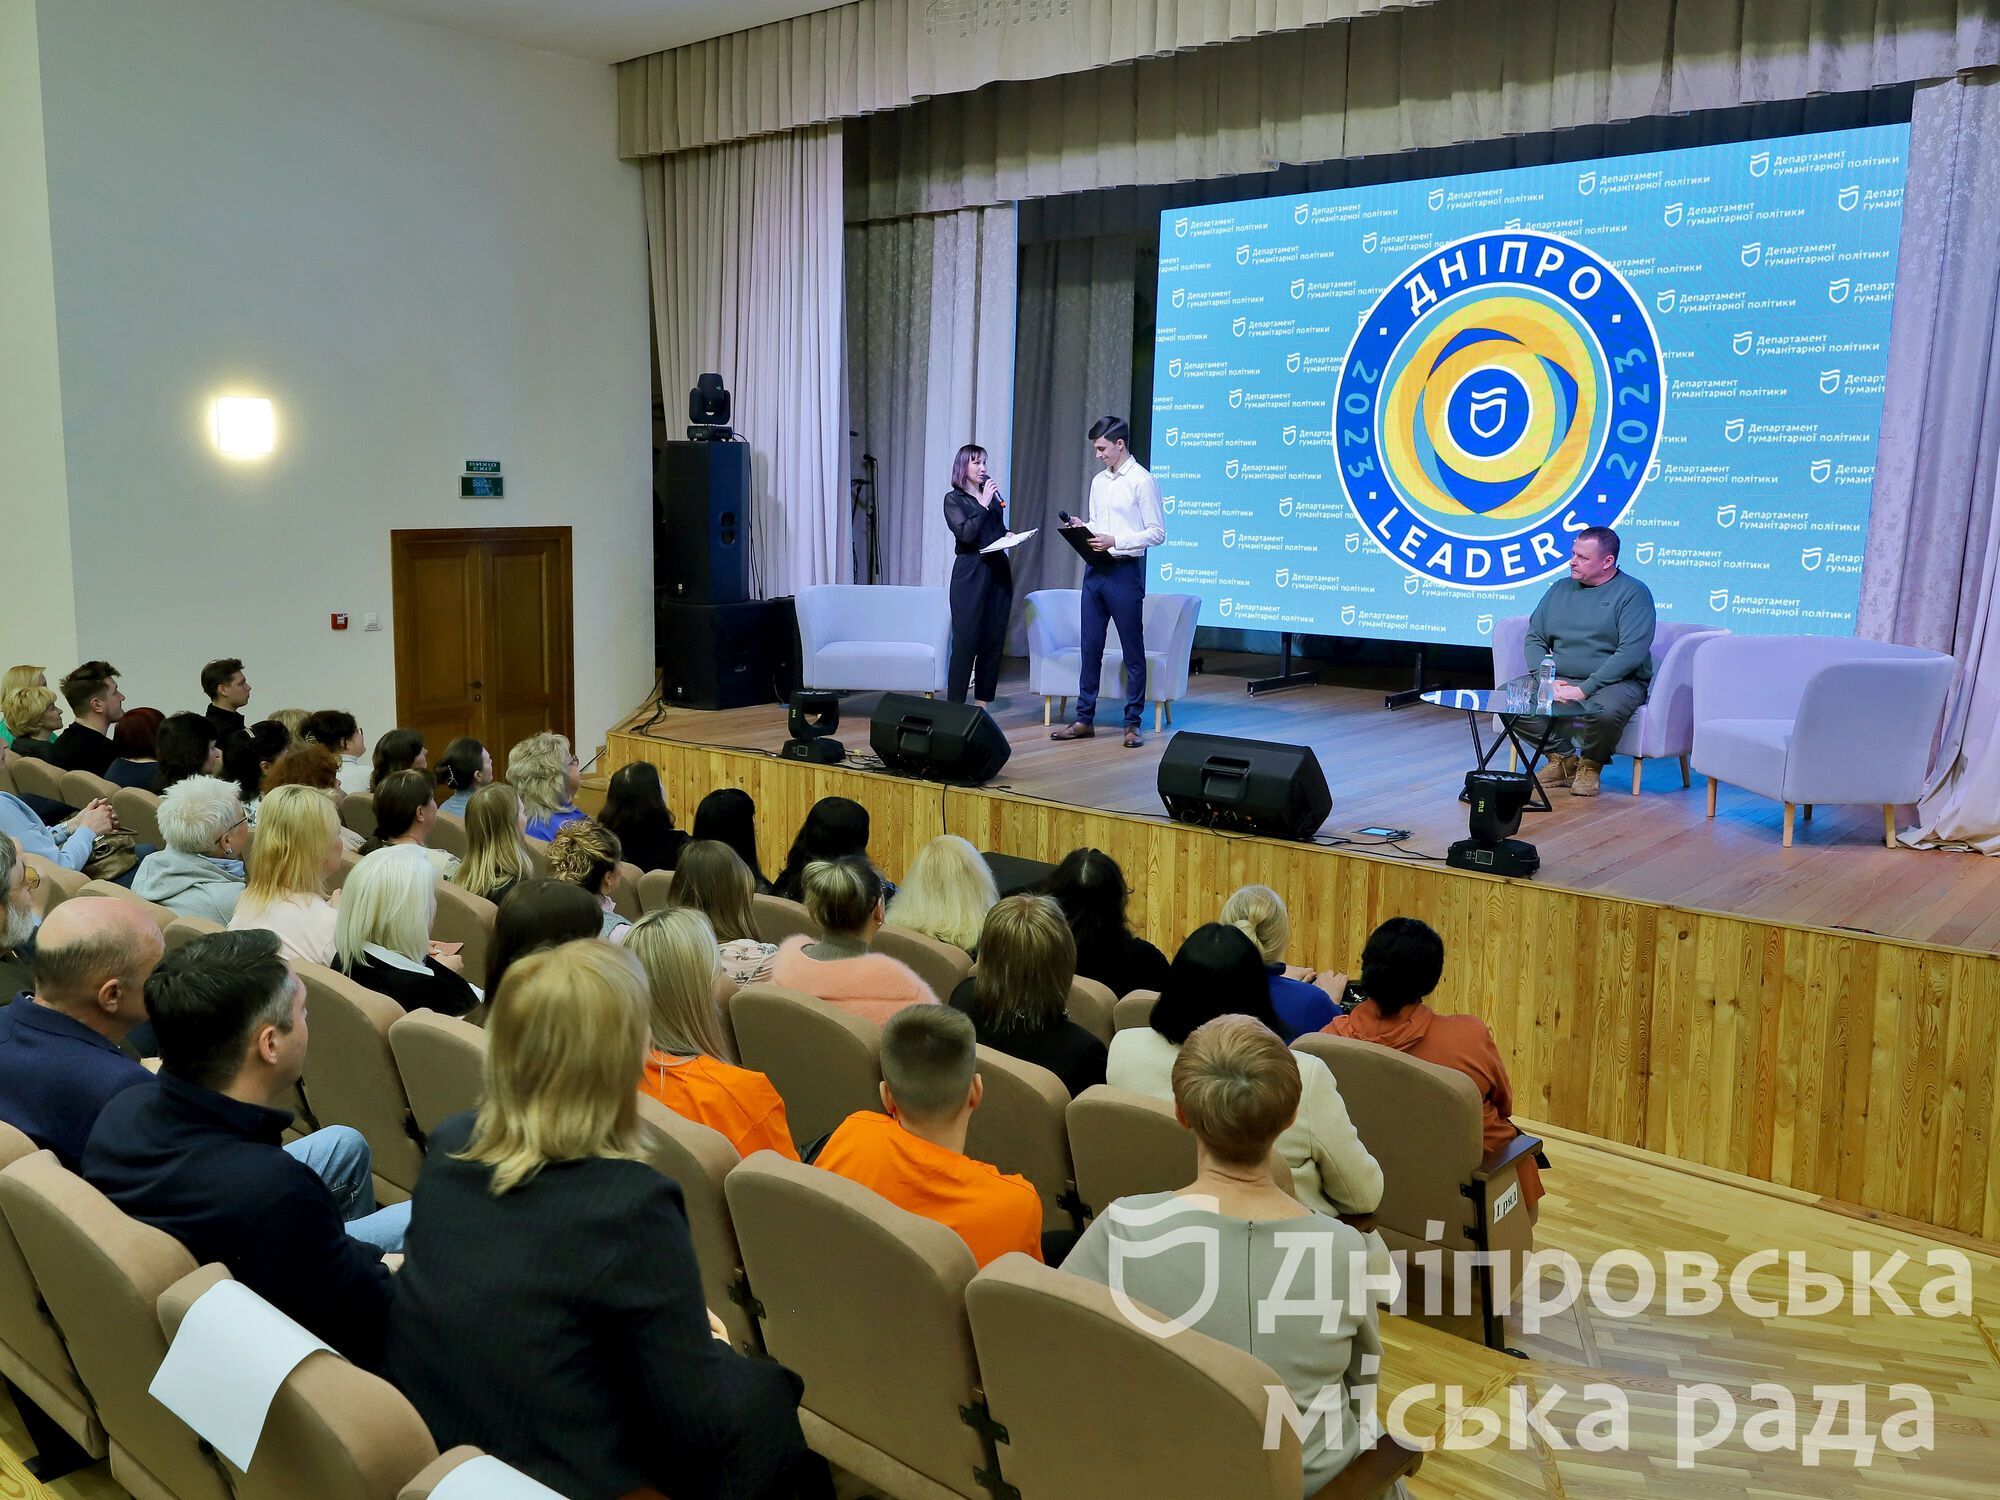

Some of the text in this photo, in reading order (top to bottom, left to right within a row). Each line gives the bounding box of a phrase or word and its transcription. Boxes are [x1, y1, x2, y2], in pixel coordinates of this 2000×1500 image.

[1774, 150, 1846, 166] Департамент
[1774, 156, 1899, 176] гуманітарної політики
[1600, 171, 1663, 185] Департамент
[1600, 175, 1710, 194] гуманітарної політики
[1447, 188, 1503, 201] Департамент
[1447, 193, 1544, 210] гуманітарної політики
[1312, 204, 1361, 215] Департамент
[1687, 202, 1755, 216] Департамент
[1311, 209, 1398, 224] гуманітарної політики
[1687, 209, 1805, 227] гуманітарної політики
[1190, 218, 1235, 229] Департамент
[1525, 218, 1583, 230] Департамент
[1190, 223, 1268, 237] гуманітарної політики
[1584, 225, 1627, 235] політики
[1381, 233, 1433, 245] Департамент
[1252, 245, 1299, 257] Департамент
[1380, 242, 1431, 253] гуманітарної
[1766, 243, 1836, 257] Департамент
[1252, 251, 1334, 265] гуманітарної політики
[1765, 250, 1889, 266] гуманітарної політики
[1181, 263, 1210, 271] політики
[1657, 264, 1702, 274] політики
[1403, 241, 1602, 317] ДНІПРО
[1308, 280, 1356, 291] Департамент
[1187, 291, 1231, 301] Департамент
[1307, 288, 1356, 299] гуманітарної
[1680, 292, 1746, 303] Департамент
[1187, 296, 1264, 307] гуманітарної політики
[1679, 299, 1796, 313] гуманітарної політики
[1249, 320, 1295, 329] Департамент
[1249, 326, 1330, 337] гуманітарної політики
[1178, 333, 1207, 341] політики
[1757, 335, 1827, 345] Департамент
[1756, 342, 1879, 356] гуманітарної політики
[1184, 362, 1227, 370] Департамент
[1184, 368, 1260, 378] гуманітарної політики
[1672, 379, 1738, 388] Департамент
[1245, 393, 1291, 401] Департамент
[1672, 388, 1786, 398] гуманітарної політики
[1175, 402, 1204, 410] політики
[1245, 400, 1325, 409] гуманітарної політики
[1344, 360, 1378, 478] 2023
[1606, 348, 1649, 480] 2023
[1749, 424, 1818, 433] Департамент
[1181, 439, 1256, 447] гуманітарної політики
[1748, 434, 1870, 443] гуманітарної політики
[1242, 464, 1287, 472] Департамент
[1665, 465, 1730, 473] Департамент
[1242, 472, 1287, 480] гуманітарної
[1665, 474, 1778, 484] гуманітарної політики
[1296, 503, 1343, 511] Департамент
[1178, 509, 1221, 517] гуманітарної
[1296, 511, 1343, 519] гуманітарної
[1741, 511, 1809, 520] Департамент
[1636, 519, 1679, 527] політики
[1740, 521, 1860, 532] гуманітарної політики
[1238, 543, 1317, 552] гуманітарної політики
[1376, 506, 1590, 579] LEADERS
[1658, 548, 1722, 558] Департамент
[1658, 558, 1769, 570] гуманітарної політики
[1175, 568, 1218, 576] Департамент
[1175, 577, 1250, 586] гуманітарної політики
[1292, 574, 1339, 582] Департамент
[1292, 583, 1339, 591] гуманітарної
[1422, 590, 1515, 600] гуманітарної політики
[1732, 595, 1800, 606] Департамент
[1235, 604, 1280, 612] Департамент
[1732, 606, 1851, 619] гуманітарної політики
[1235, 612, 1280, 620] гуманітарної
[1359, 611, 1409, 620] Департамент
[1359, 620, 1446, 632] гуманітарної політики
